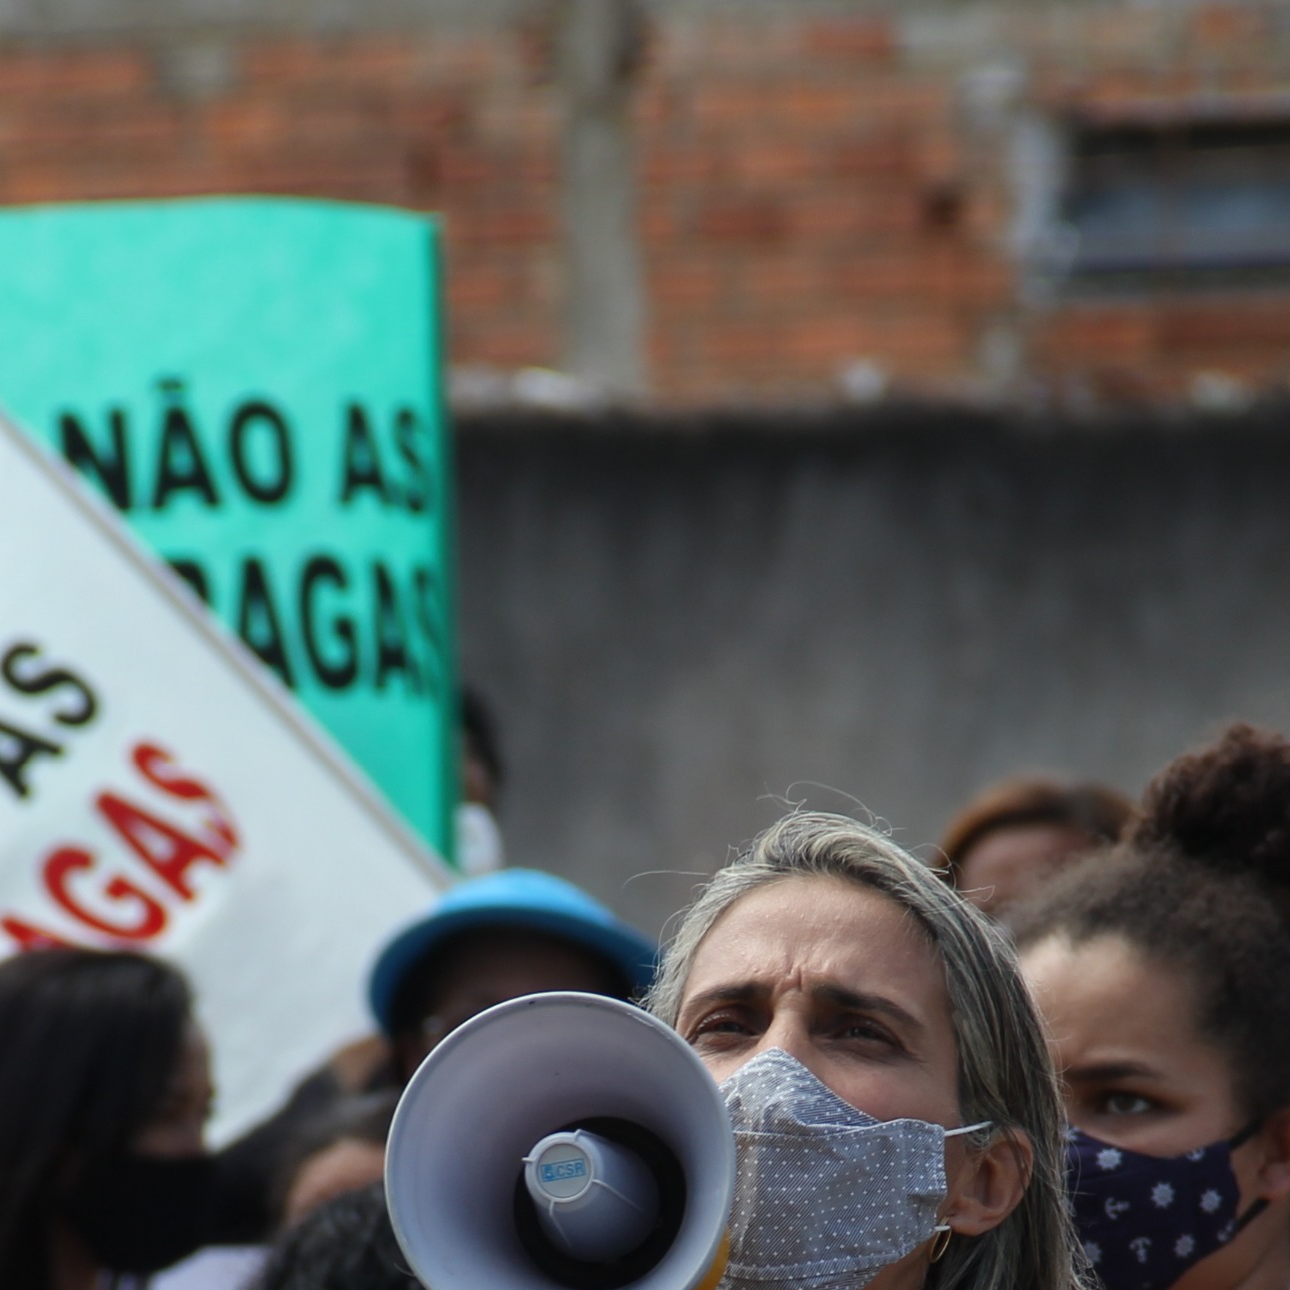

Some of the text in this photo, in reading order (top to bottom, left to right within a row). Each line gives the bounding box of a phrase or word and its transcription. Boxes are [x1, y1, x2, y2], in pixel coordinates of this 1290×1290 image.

[60, 378, 429, 513] NÃO AS
[557, 1160, 586, 1177] CSR
